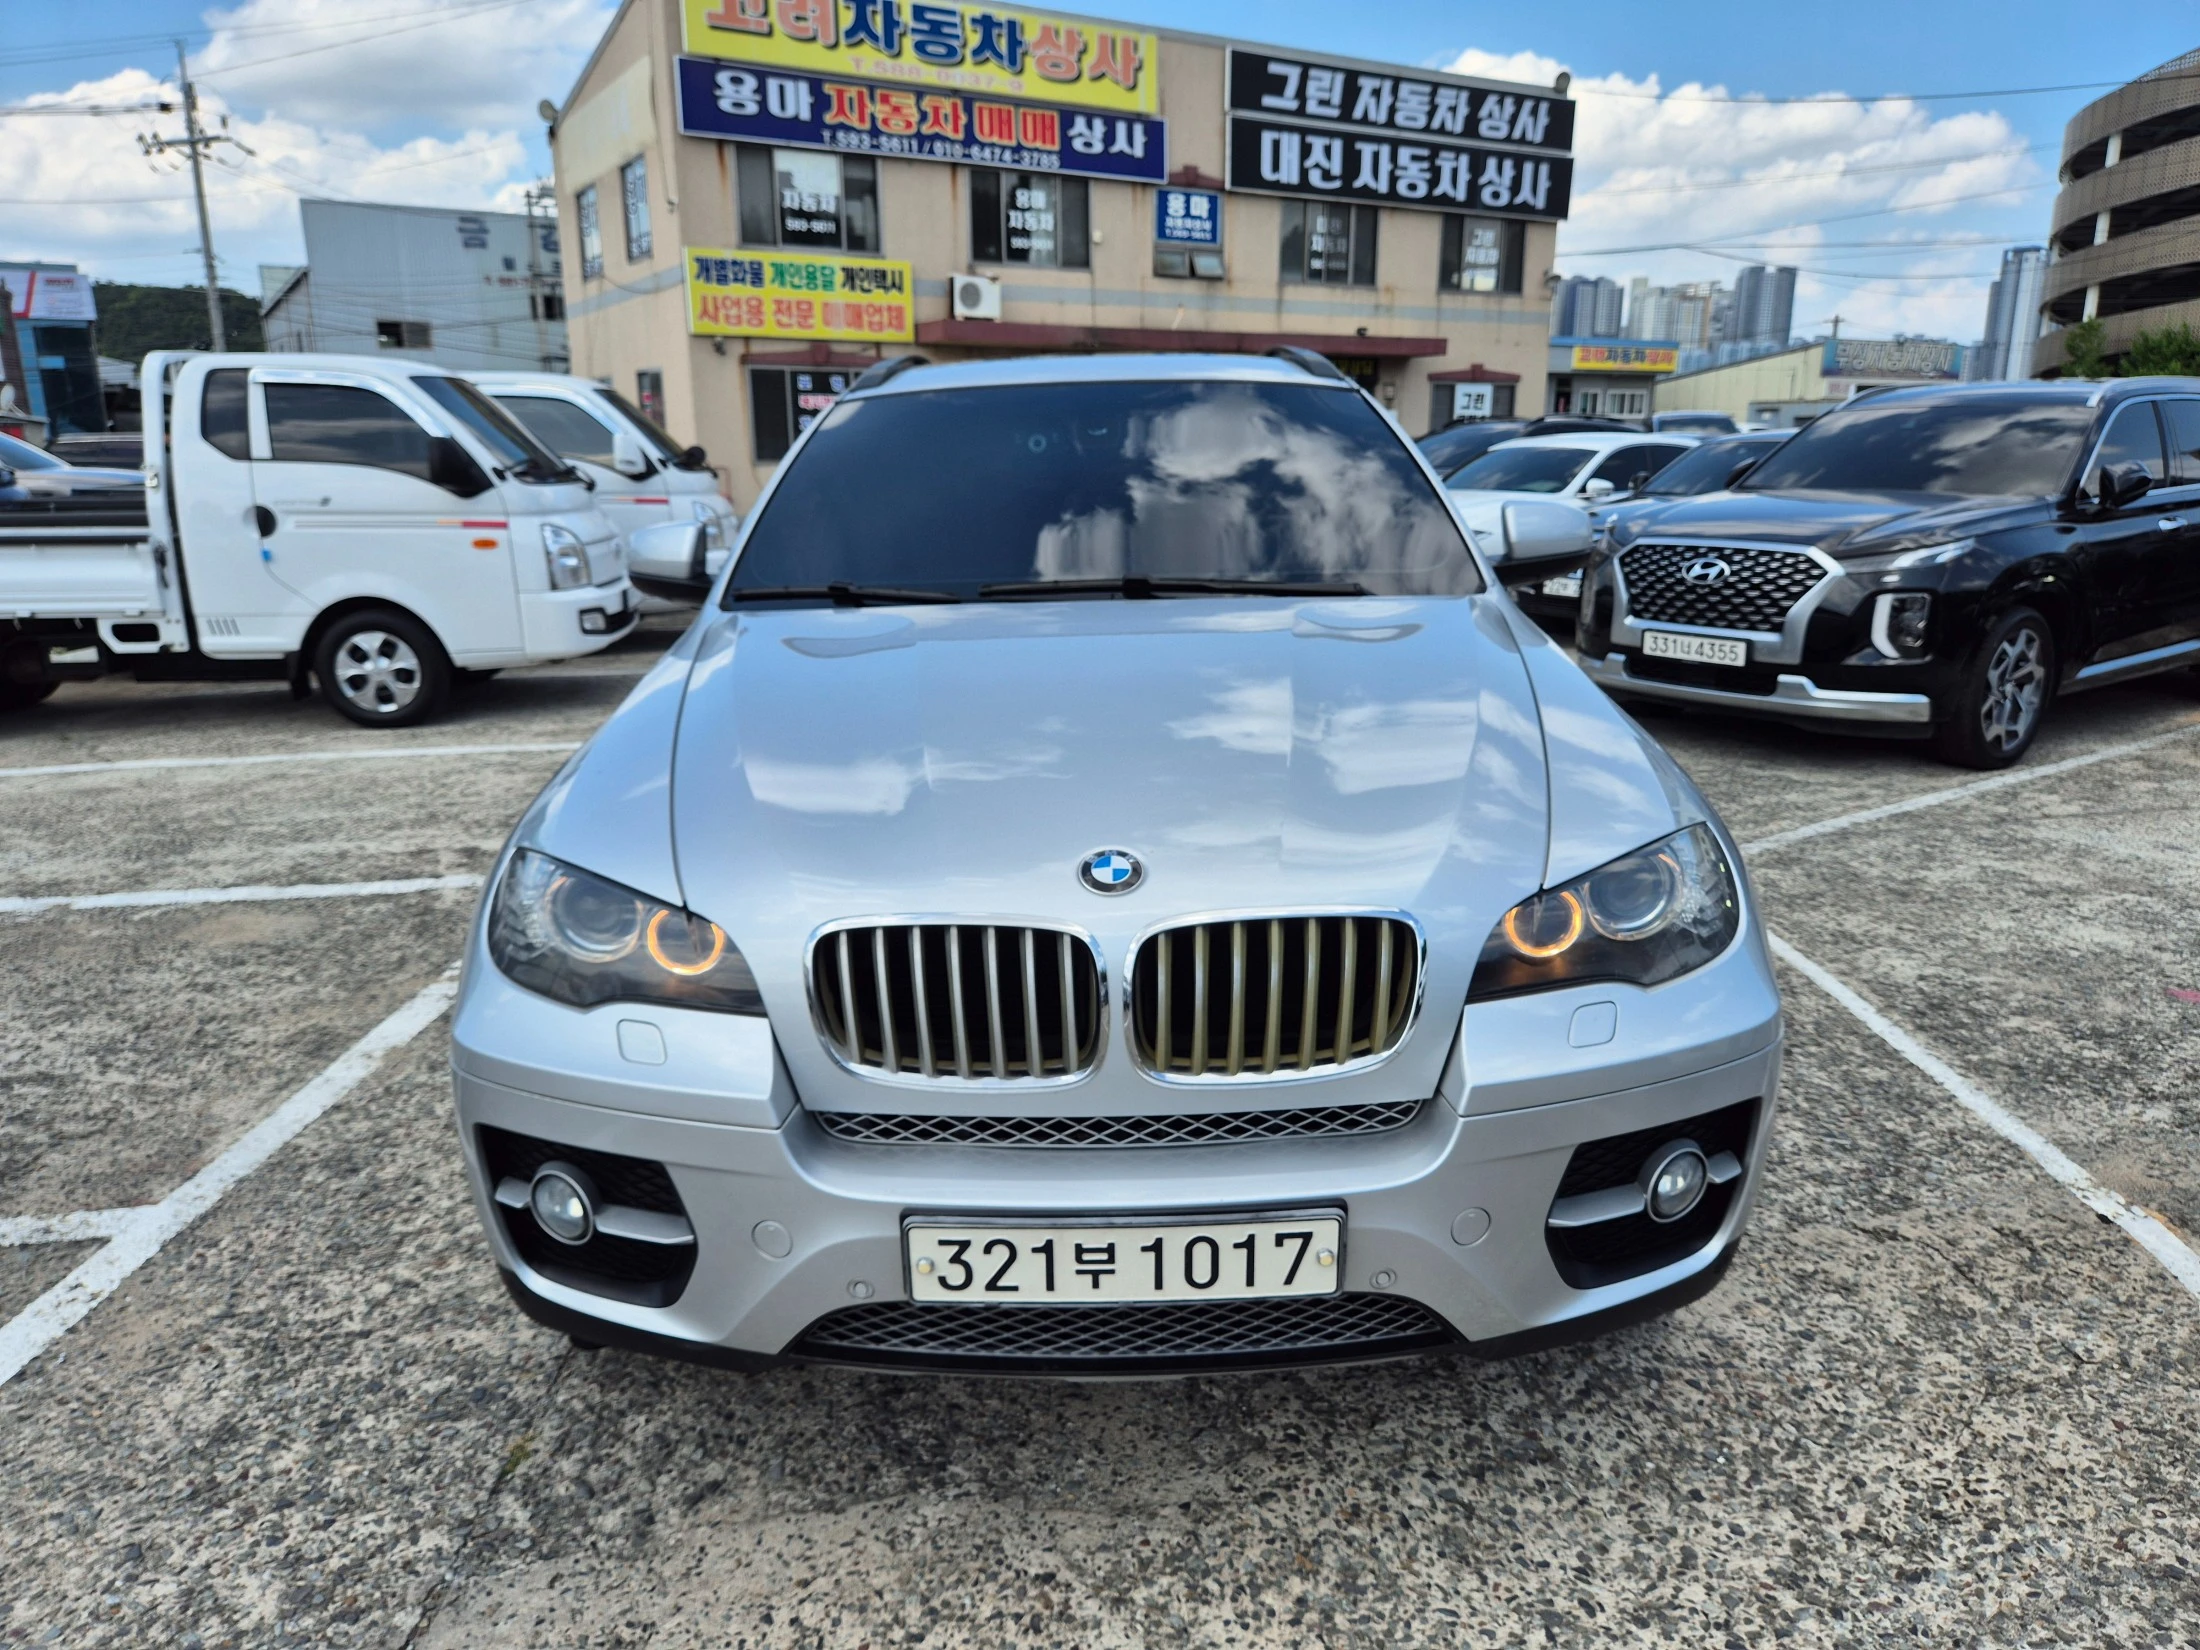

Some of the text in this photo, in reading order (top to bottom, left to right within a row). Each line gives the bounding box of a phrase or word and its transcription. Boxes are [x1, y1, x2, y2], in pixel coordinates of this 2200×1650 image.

[713, 68, 815, 121] 용마
[1066, 114, 1148, 159] 상사
[1261, 60, 1550, 144] 그린 자동차 상사
[1260, 129, 1551, 211] 대진 자동차 상사
[937, 1231, 1314, 1292] 321부 1017
